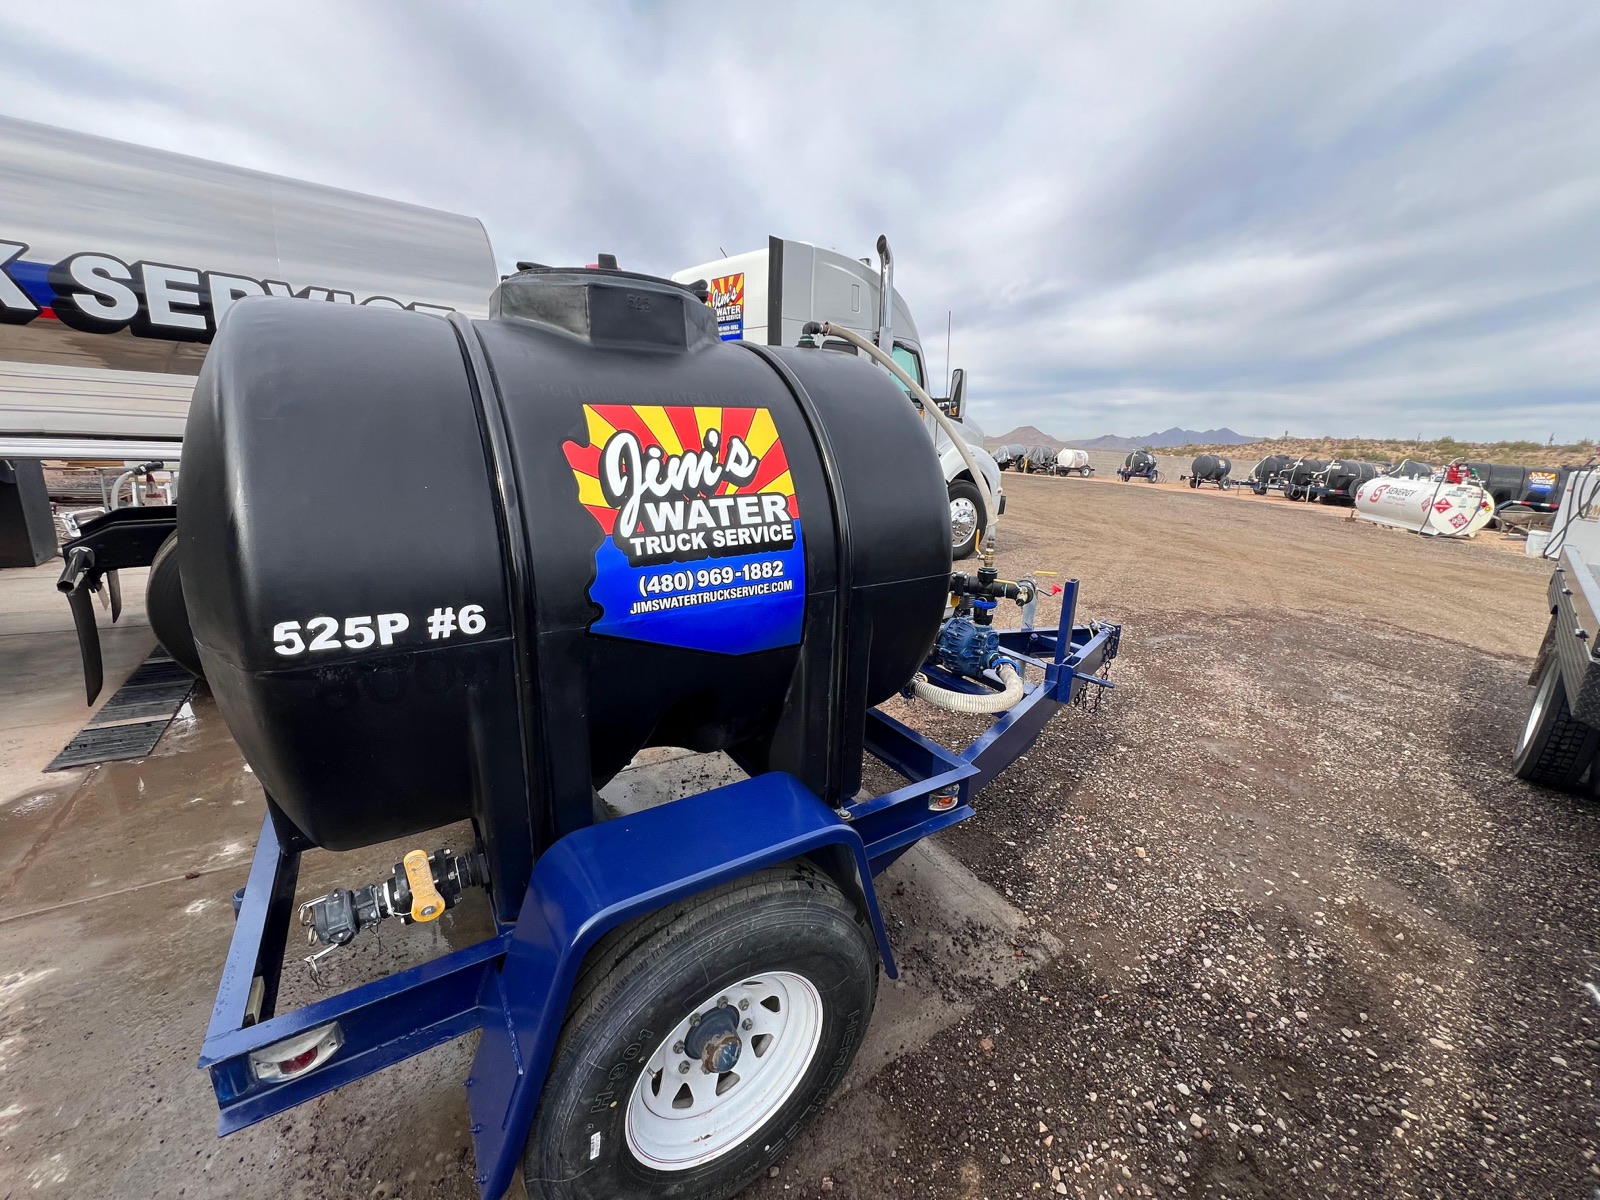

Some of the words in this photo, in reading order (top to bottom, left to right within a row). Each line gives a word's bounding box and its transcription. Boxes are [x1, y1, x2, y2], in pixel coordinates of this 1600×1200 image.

[712, 284, 737, 310] Jim's
[717, 305, 741, 317] WATER
[605, 430, 757, 538] Jim's
[1386, 486, 1418, 498] SENERGY
[645, 494, 791, 532] WATER
[630, 531, 707, 556] TRUCK
[713, 523, 794, 549] SERVICE
[639, 570, 694, 597] (480)
[697, 560, 784, 587] 969-1882
[630, 580, 793, 615] JIMSWATERTRUCKSERVICE.COM
[273, 612, 409, 656] 525P
[427, 604, 487, 640] #6
[591, 1028, 655, 1114] H-901
